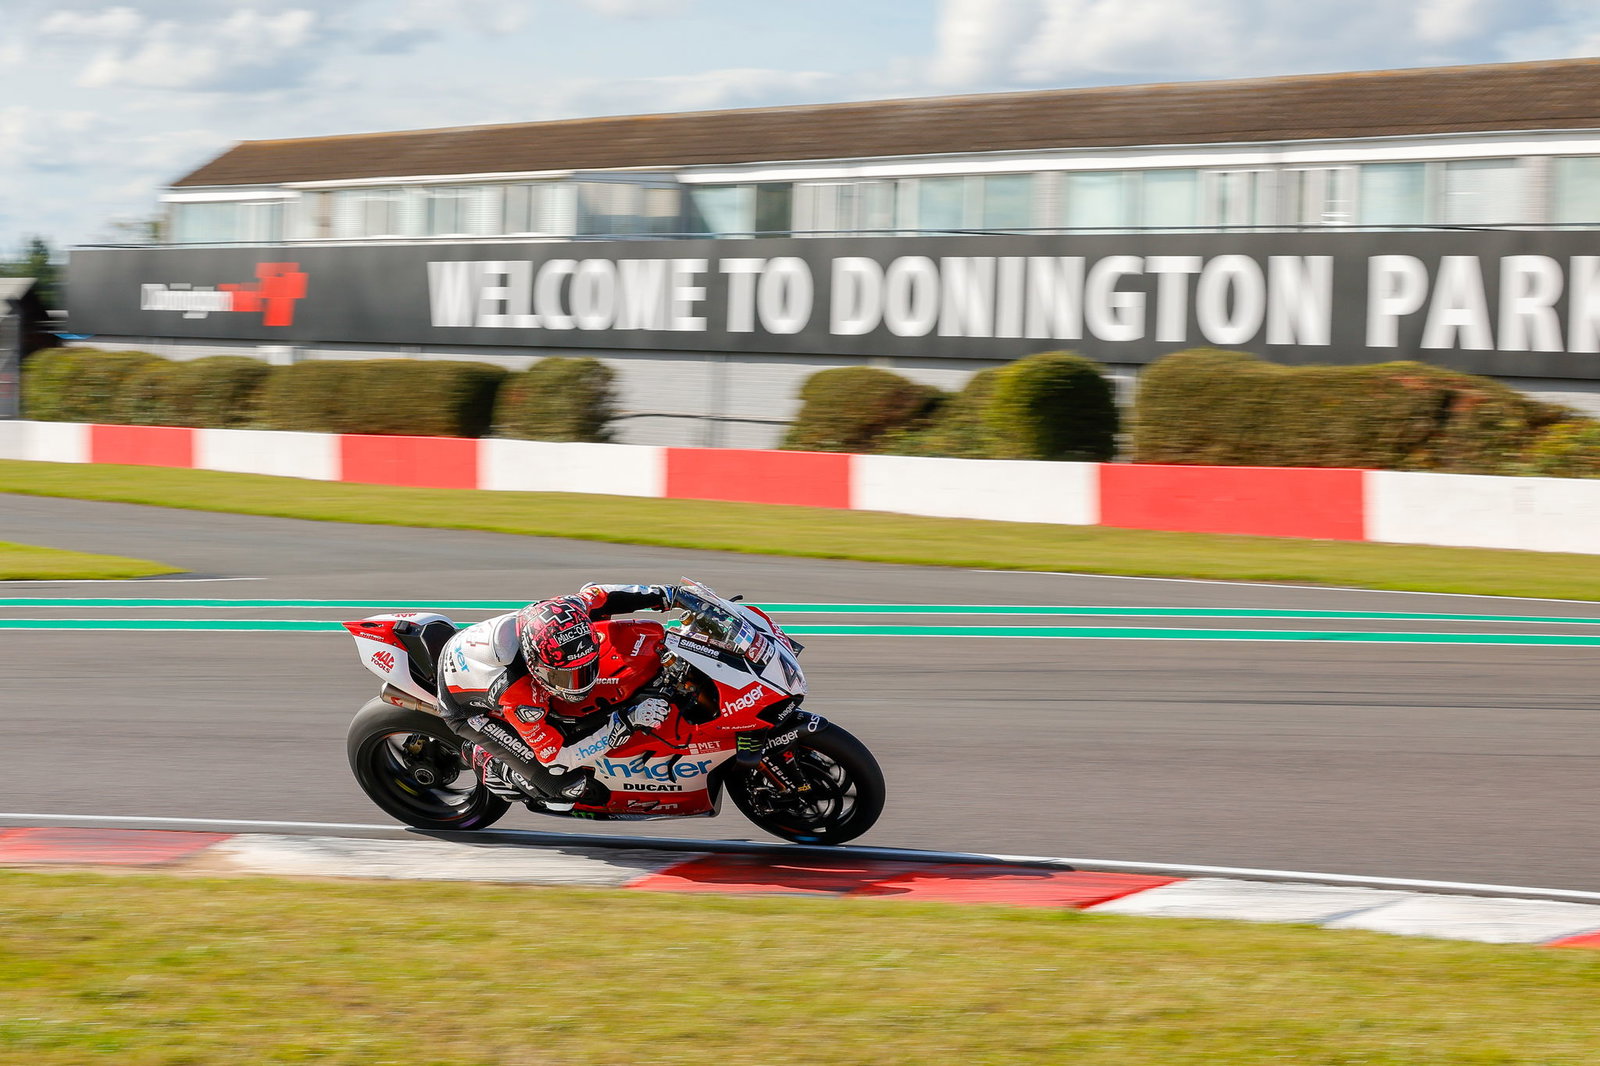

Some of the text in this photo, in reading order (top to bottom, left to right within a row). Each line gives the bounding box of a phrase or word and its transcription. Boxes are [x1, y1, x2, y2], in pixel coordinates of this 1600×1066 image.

[428, 258, 708, 331] WELCOME
[719, 257, 814, 335] TO
[830, 254, 1334, 345] DONINGTON
[566, 645, 595, 661] SHARK
[680, 639, 720, 657] Silkolene
[370, 656, 392, 674] TOOLS
[372, 650, 395, 669] MAC
[483, 723, 535, 760] Silkolene
[697, 741, 720, 750] MET
[623, 783, 682, 792] DUCATI
